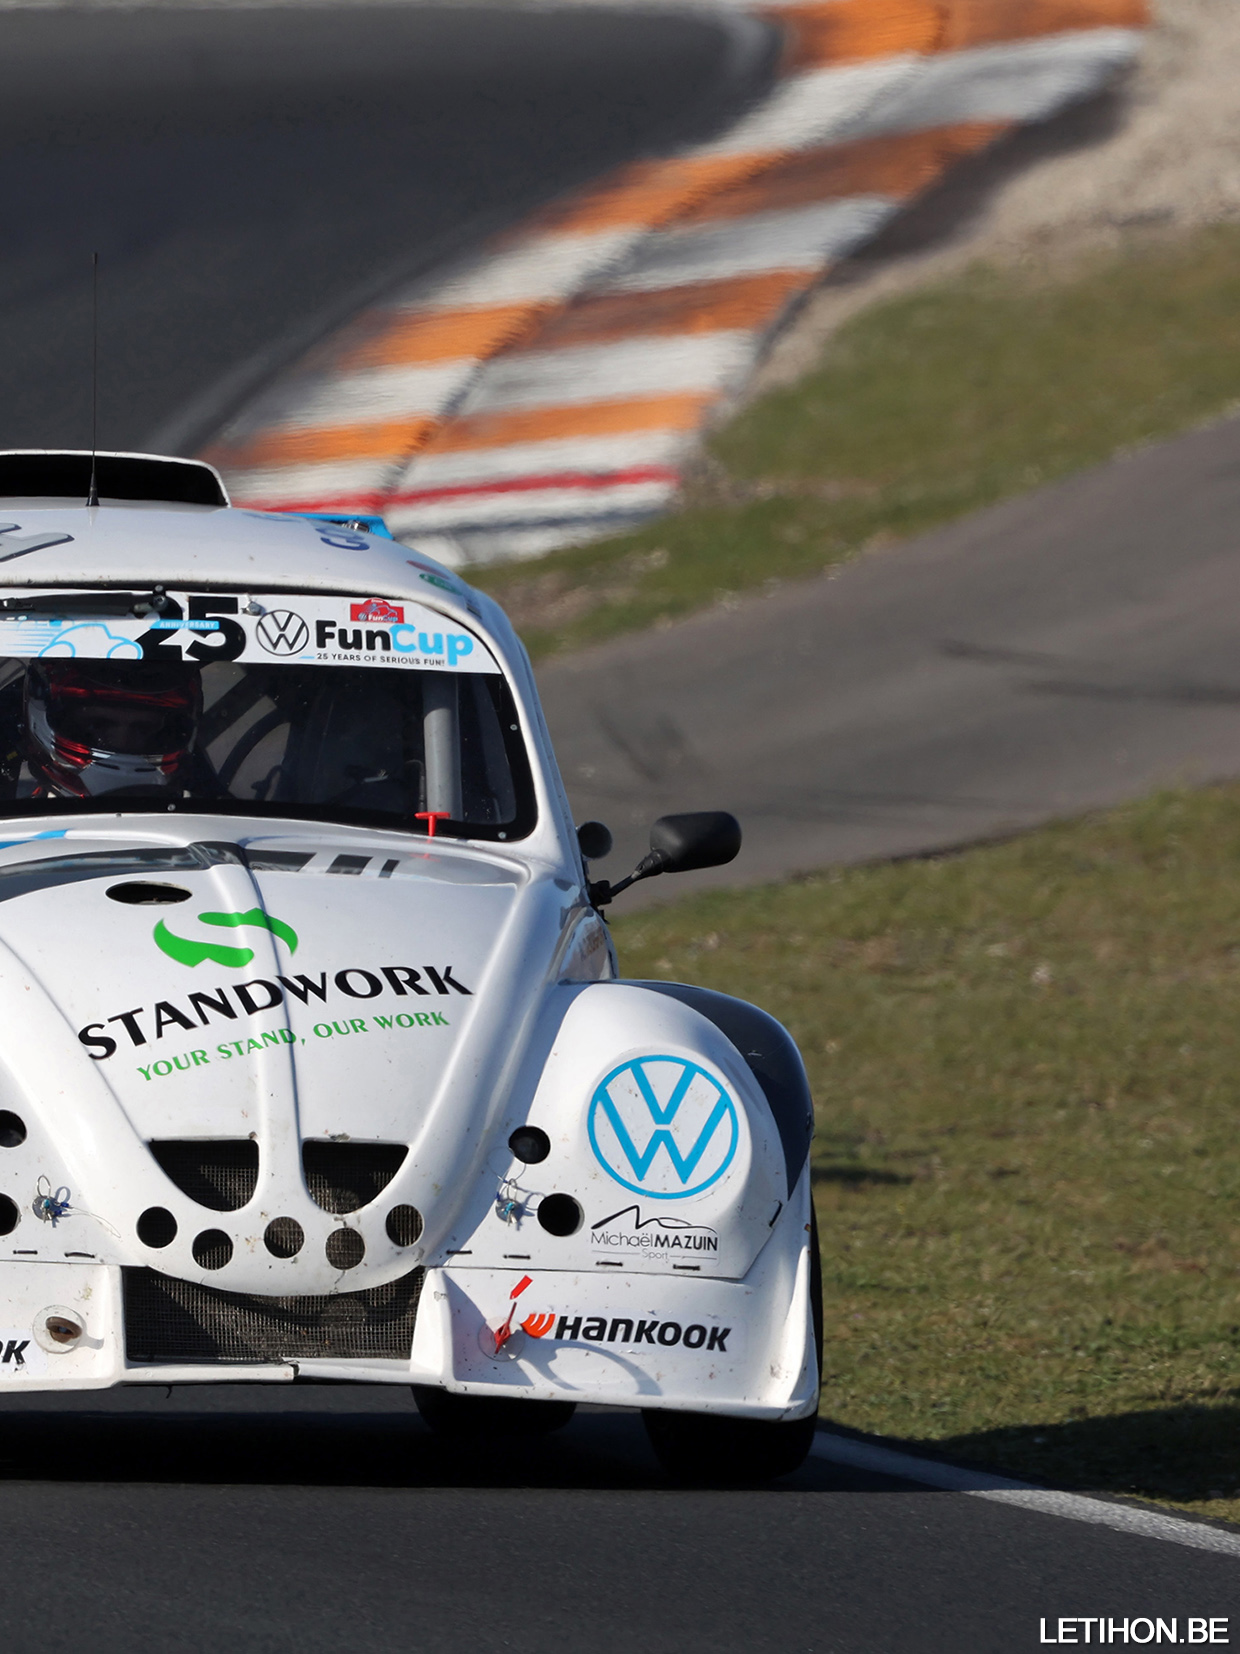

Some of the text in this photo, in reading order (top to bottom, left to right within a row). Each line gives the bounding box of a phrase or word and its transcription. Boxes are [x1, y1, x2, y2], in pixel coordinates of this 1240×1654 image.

[133, 594, 247, 662] 25
[315, 619, 474, 667] FunCup
[316, 652, 329, 660] 25
[332, 653, 361, 662] YEARS
[380, 656, 420, 665] SERIOUS
[423, 658, 445, 667] FUN!
[77, 965, 475, 1061] STANDWORK
[136, 1010, 451, 1082] YOUR STAND, OUR WORK
[641, 1249, 668, 1260] Sport
